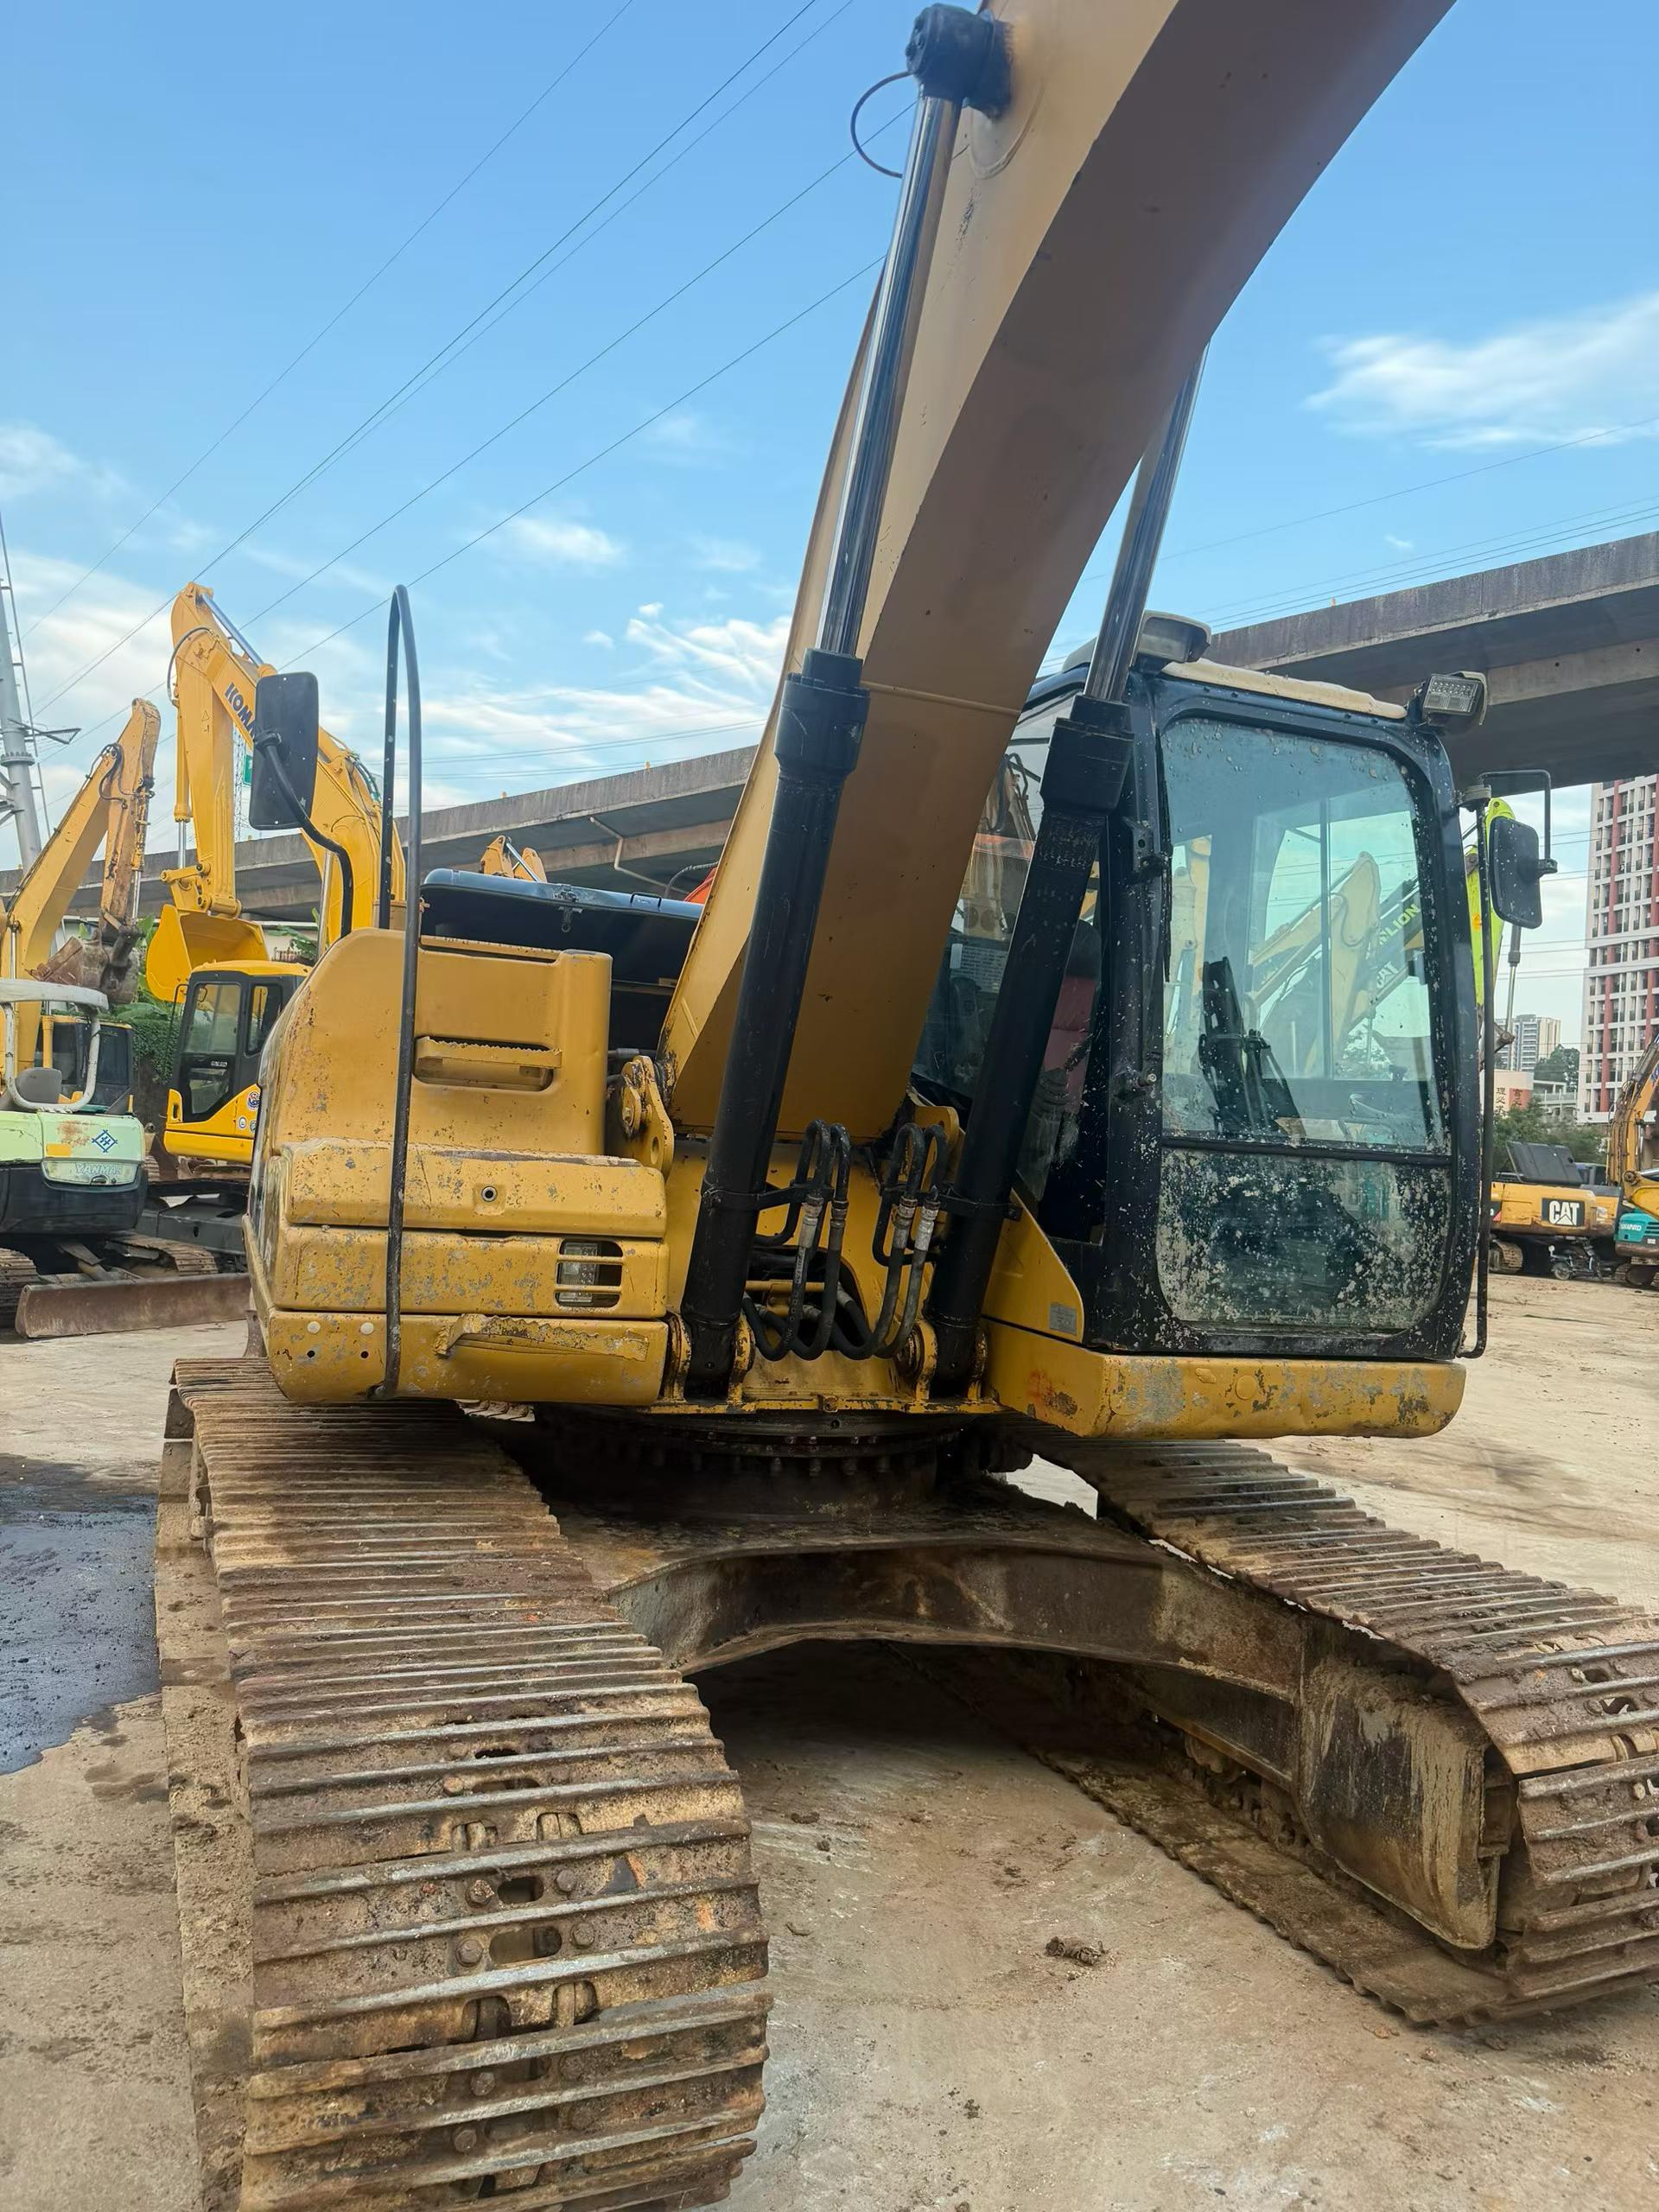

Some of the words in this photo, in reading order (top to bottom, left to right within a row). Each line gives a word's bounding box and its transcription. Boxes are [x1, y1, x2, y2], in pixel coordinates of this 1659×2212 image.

[225, 682, 257, 742] KOMA
[1376, 960, 1399, 989] CAT
[1549, 1200, 1580, 1226] CAT
